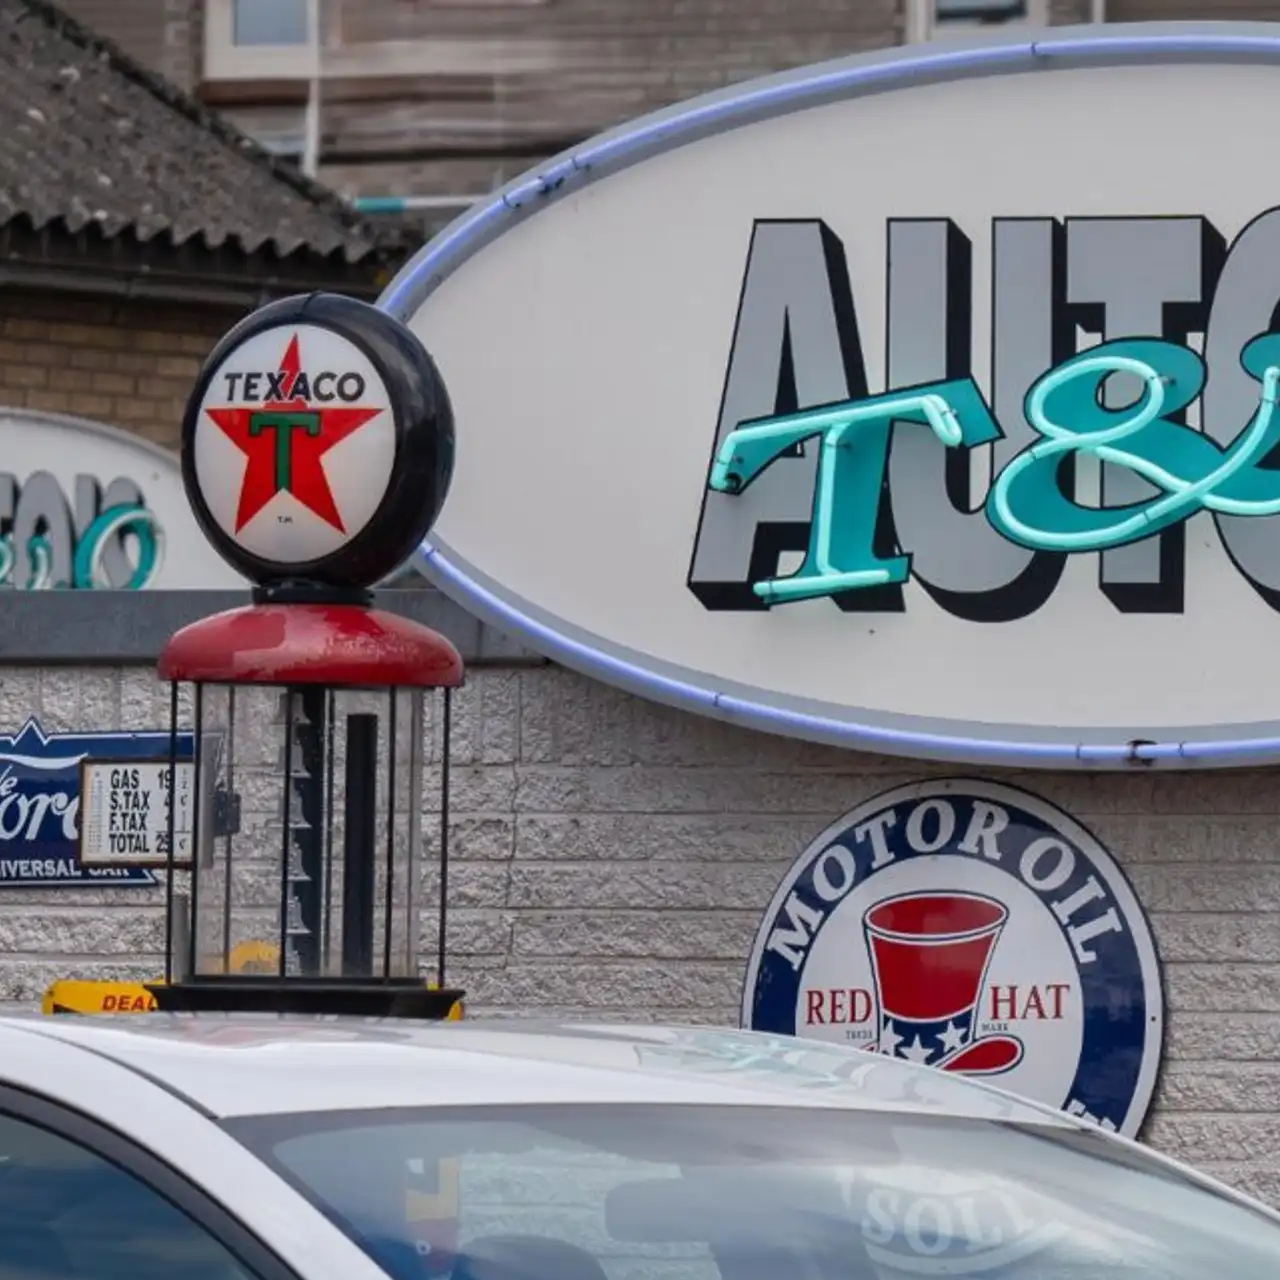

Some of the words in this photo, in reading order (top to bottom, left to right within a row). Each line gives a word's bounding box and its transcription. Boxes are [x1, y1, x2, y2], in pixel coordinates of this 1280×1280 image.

[224, 371, 365, 402] TEXACO
[110, 768, 140, 790] GAS
[109, 790, 151, 811] S.TAX
[109, 811, 148, 832] F.TAX
[108, 833, 150, 853] TOTAL
[767, 799, 1011, 972] MOTOR
[1020, 836, 1124, 965] OIL
[805, 988, 873, 1026] RED
[990, 984, 1071, 1020] HAT
